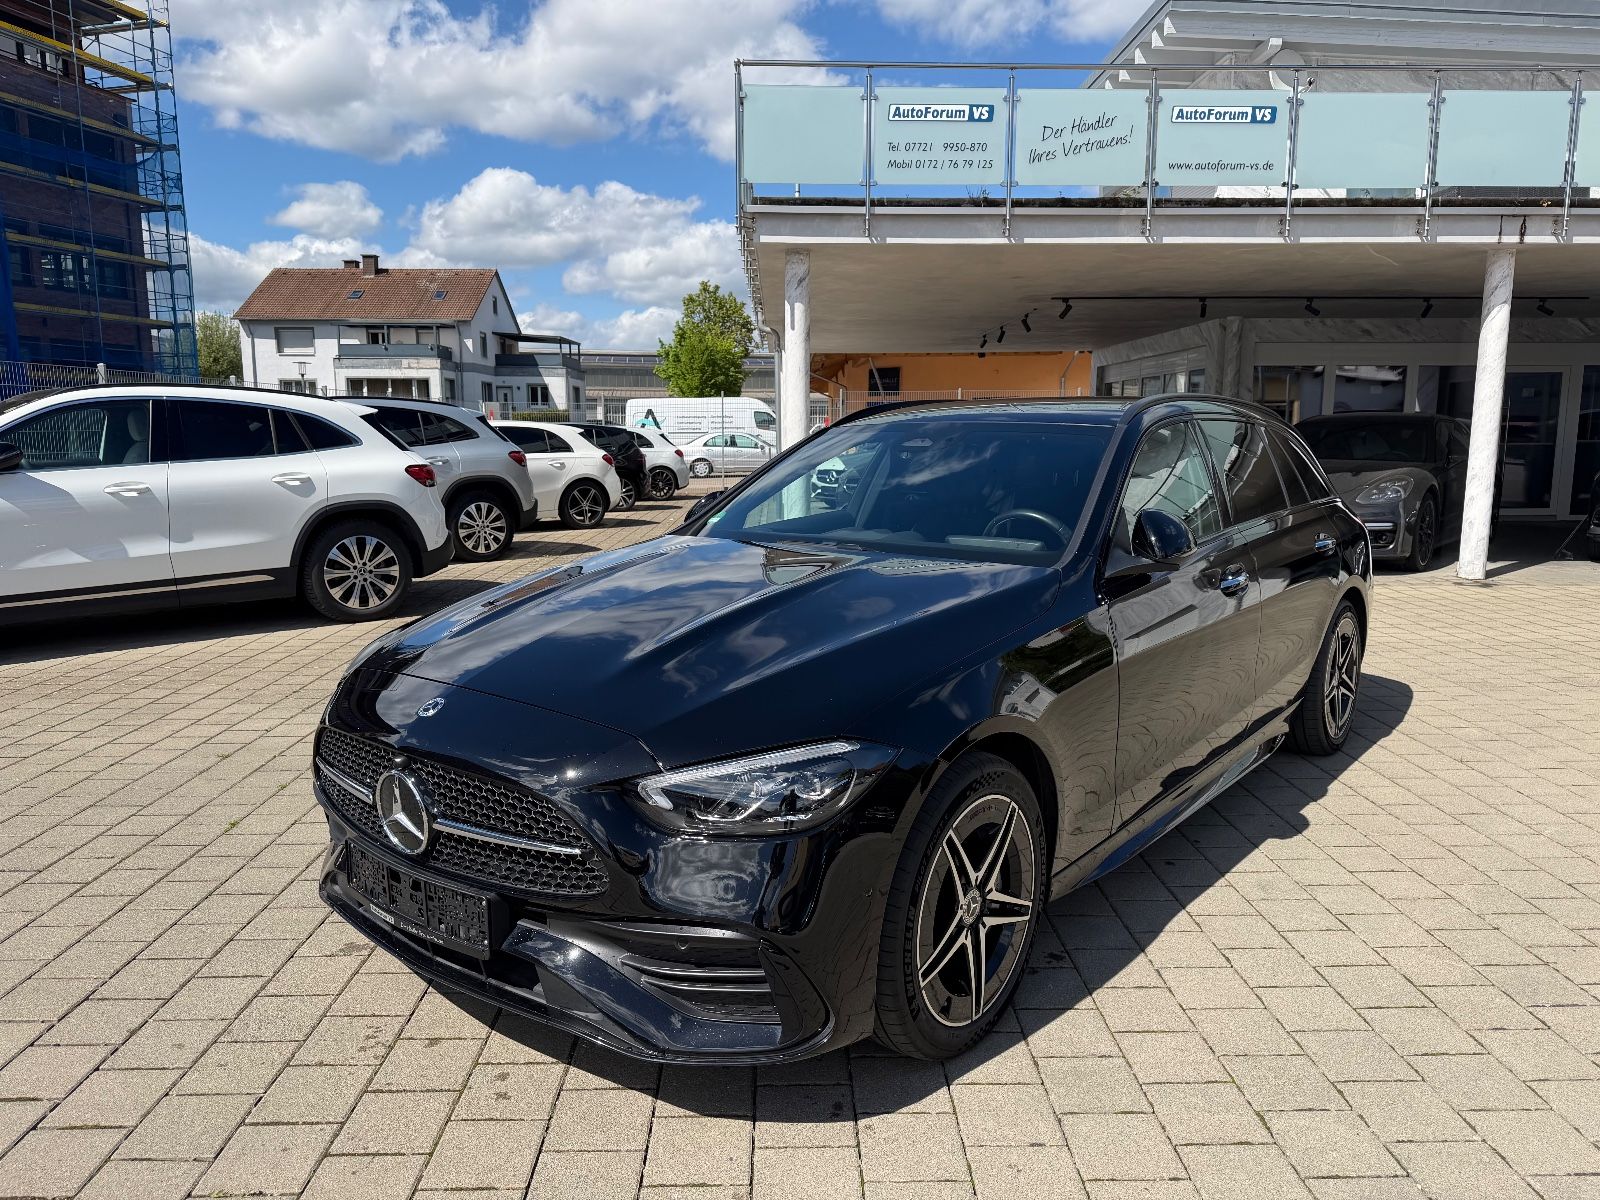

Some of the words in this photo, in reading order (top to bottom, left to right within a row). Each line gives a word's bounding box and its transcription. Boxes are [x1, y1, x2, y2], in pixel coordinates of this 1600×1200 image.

[891, 106, 966, 119] AutoForum
[972, 106, 990, 120] VS
[1174, 108, 1249, 121] AutoForum
[1255, 108, 1272, 122] VS
[1041, 125, 1067, 142] Der
[1070, 111, 1118, 135] Händler
[887, 142, 901, 152] Tel.
[904, 142, 933, 152] 07721
[942, 142, 988, 152] 9950-870
[1028, 148, 1057, 165] Ihres
[1062, 124, 1134, 157] Vertrauens!
[887, 159, 913, 169] Mobil
[915, 159, 938, 169] 0172
[947, 159, 959, 169] 76
[962, 159, 974, 169] 79
[977, 159, 994, 169] 125
[1168, 159, 1275, 173] www.autoforum-vs.de
[903, 905, 917, 1002] MICHELIN
